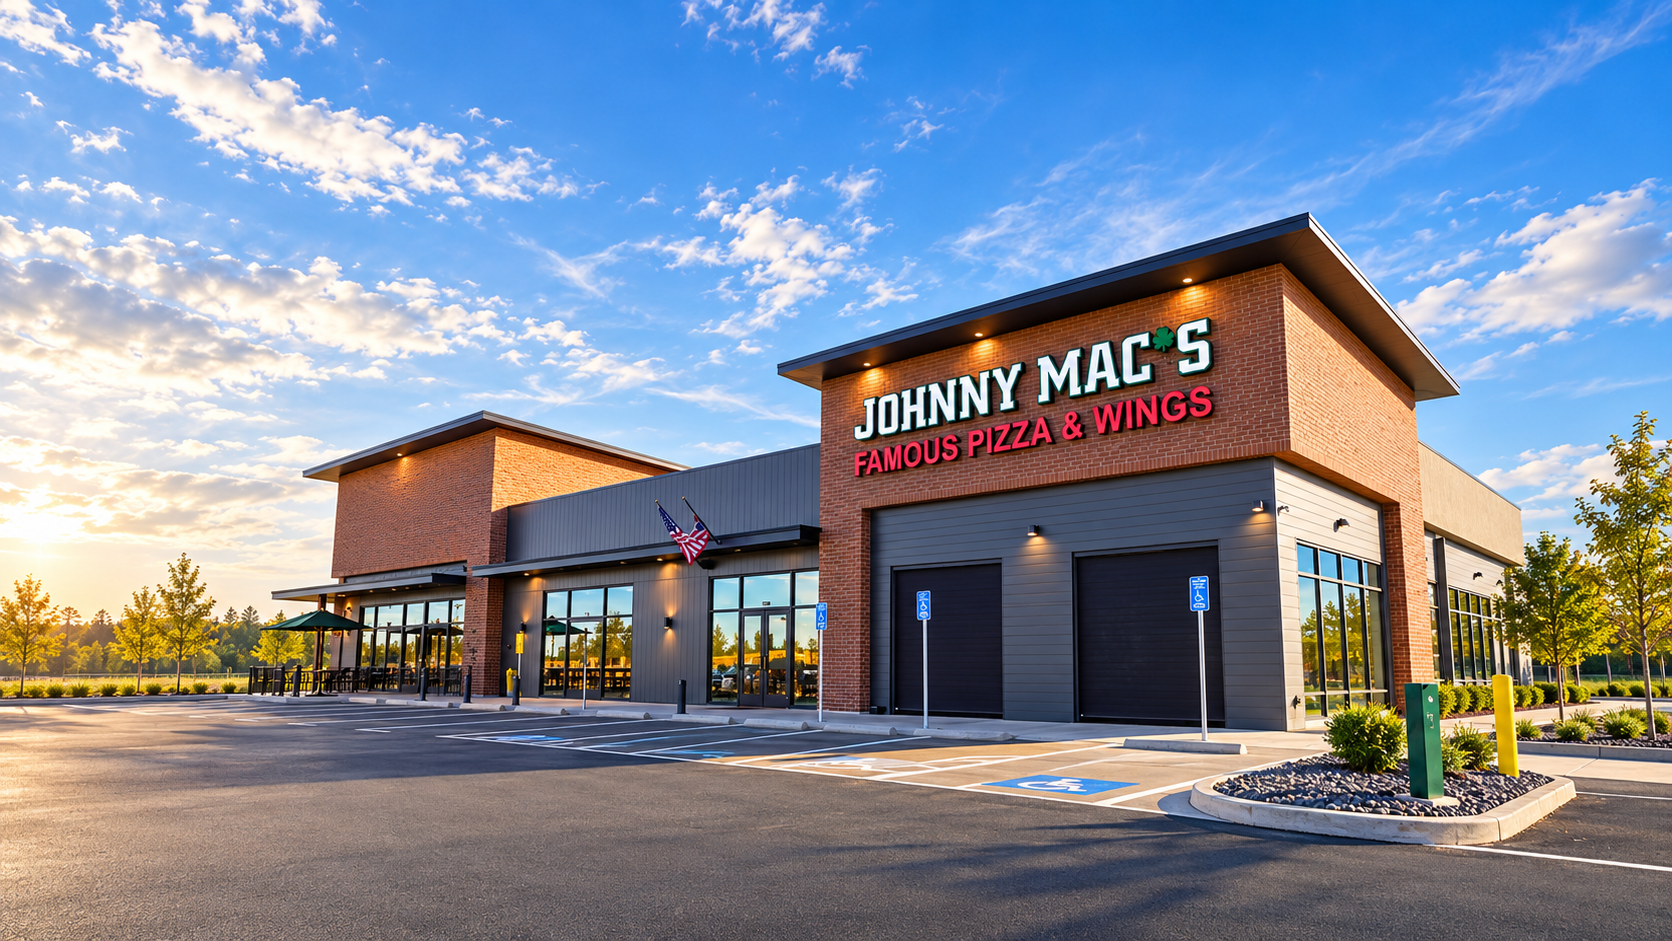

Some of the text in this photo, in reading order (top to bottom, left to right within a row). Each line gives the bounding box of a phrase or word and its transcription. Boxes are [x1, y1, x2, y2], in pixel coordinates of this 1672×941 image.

[853, 361, 1024, 441] JOHNNY
[854, 385, 1213, 477] FAMOUS PIZZA & WINGS
